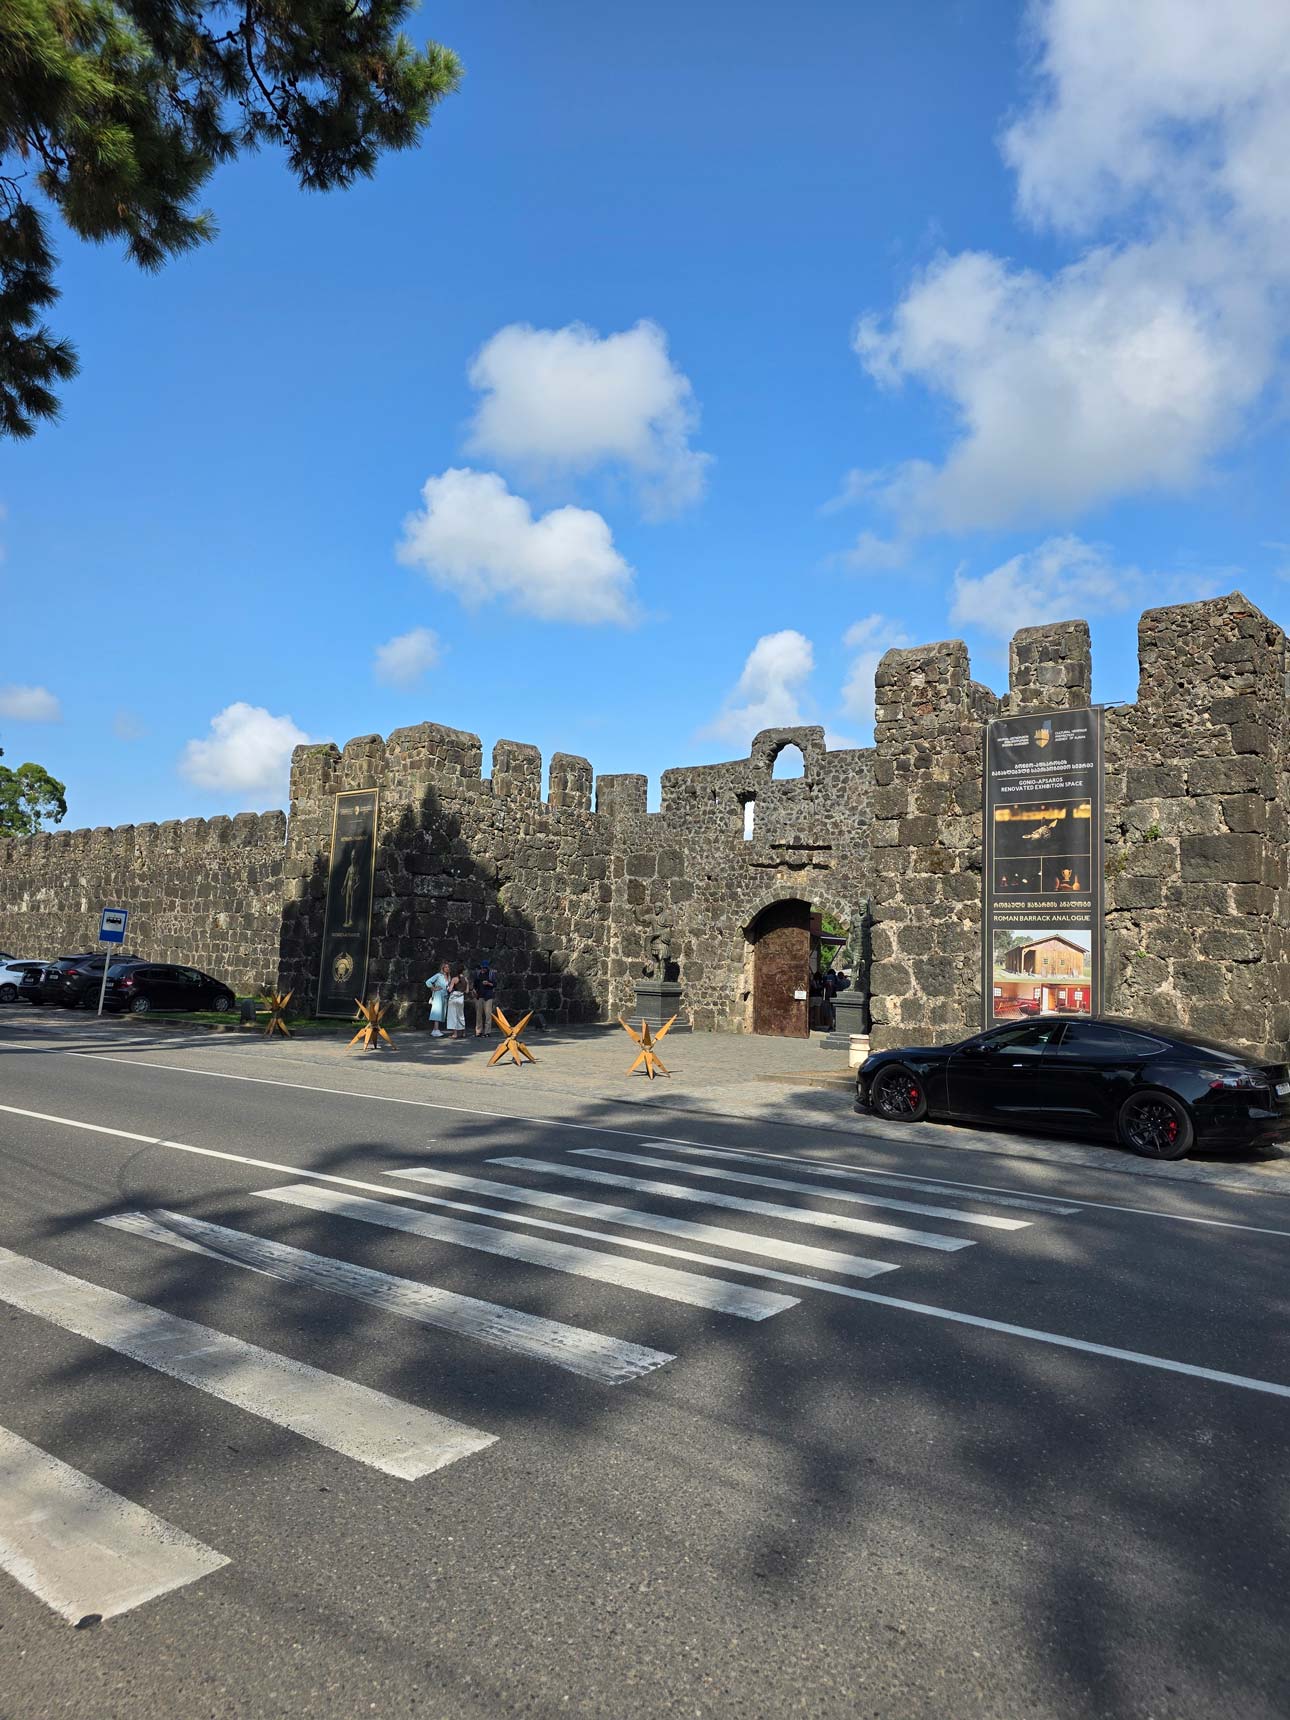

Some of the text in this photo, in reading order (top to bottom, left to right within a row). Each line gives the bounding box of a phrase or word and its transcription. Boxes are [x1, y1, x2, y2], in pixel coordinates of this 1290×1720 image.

[1019, 777, 1063, 785] GONIO-APSAROS
[1001, 784, 1035, 792] RENOVATED
[1035, 782, 1065, 790] EXHIBITION
